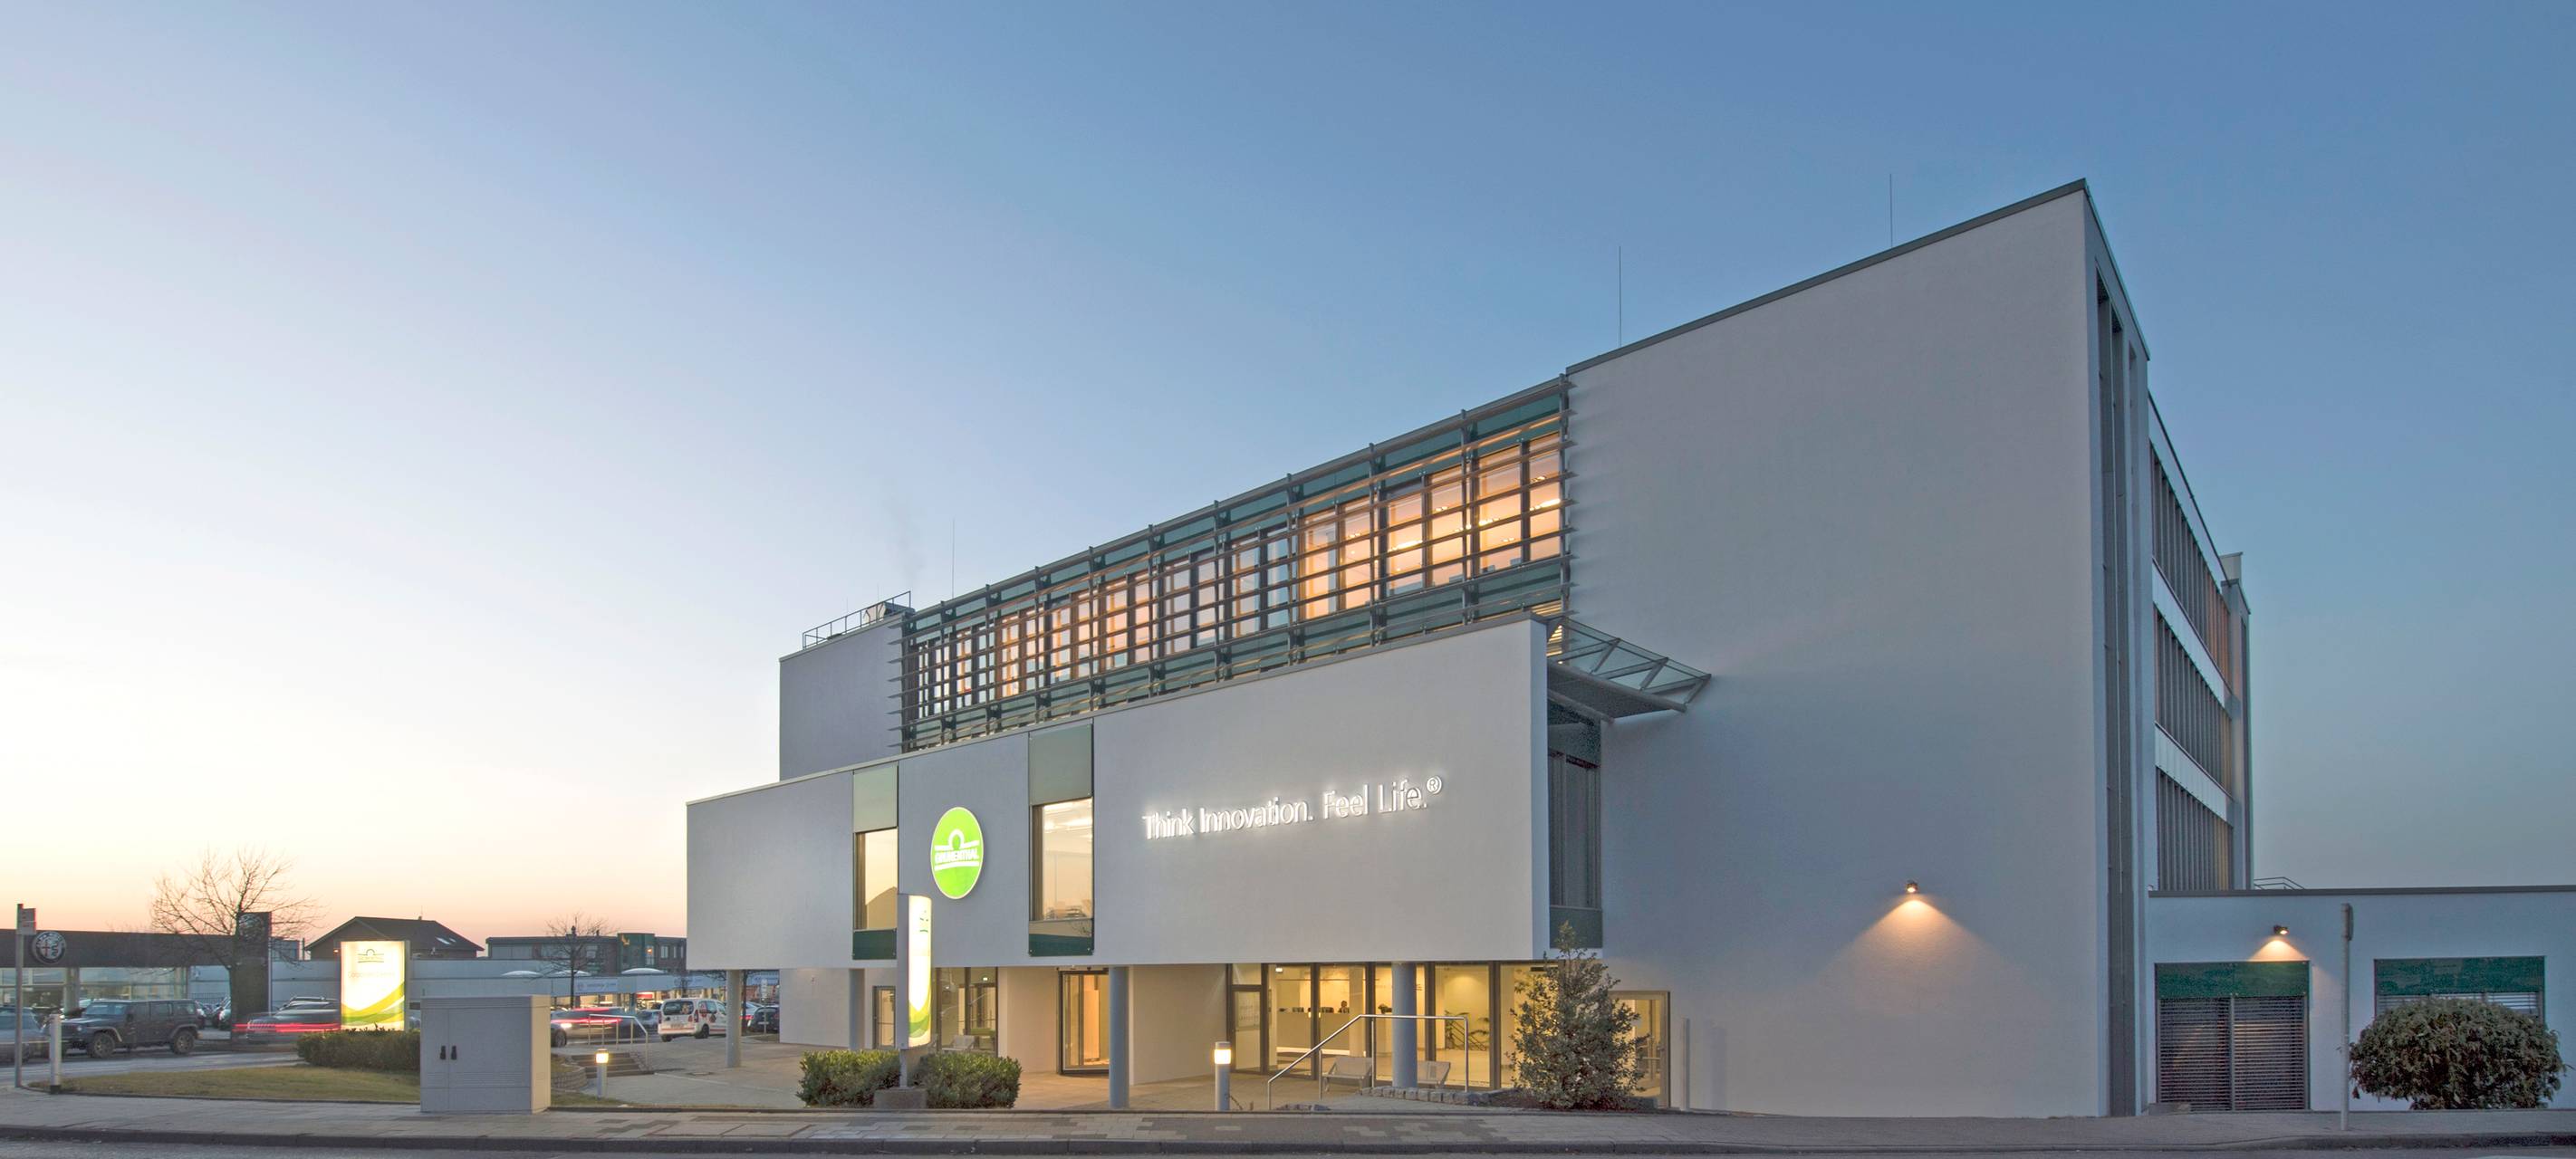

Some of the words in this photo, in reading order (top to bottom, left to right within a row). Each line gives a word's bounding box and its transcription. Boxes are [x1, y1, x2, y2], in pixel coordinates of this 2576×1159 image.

[1142, 809, 1195, 839] Think
[1199, 796, 1313, 833] Innovation.
[1322, 784, 1369, 819] Feel
